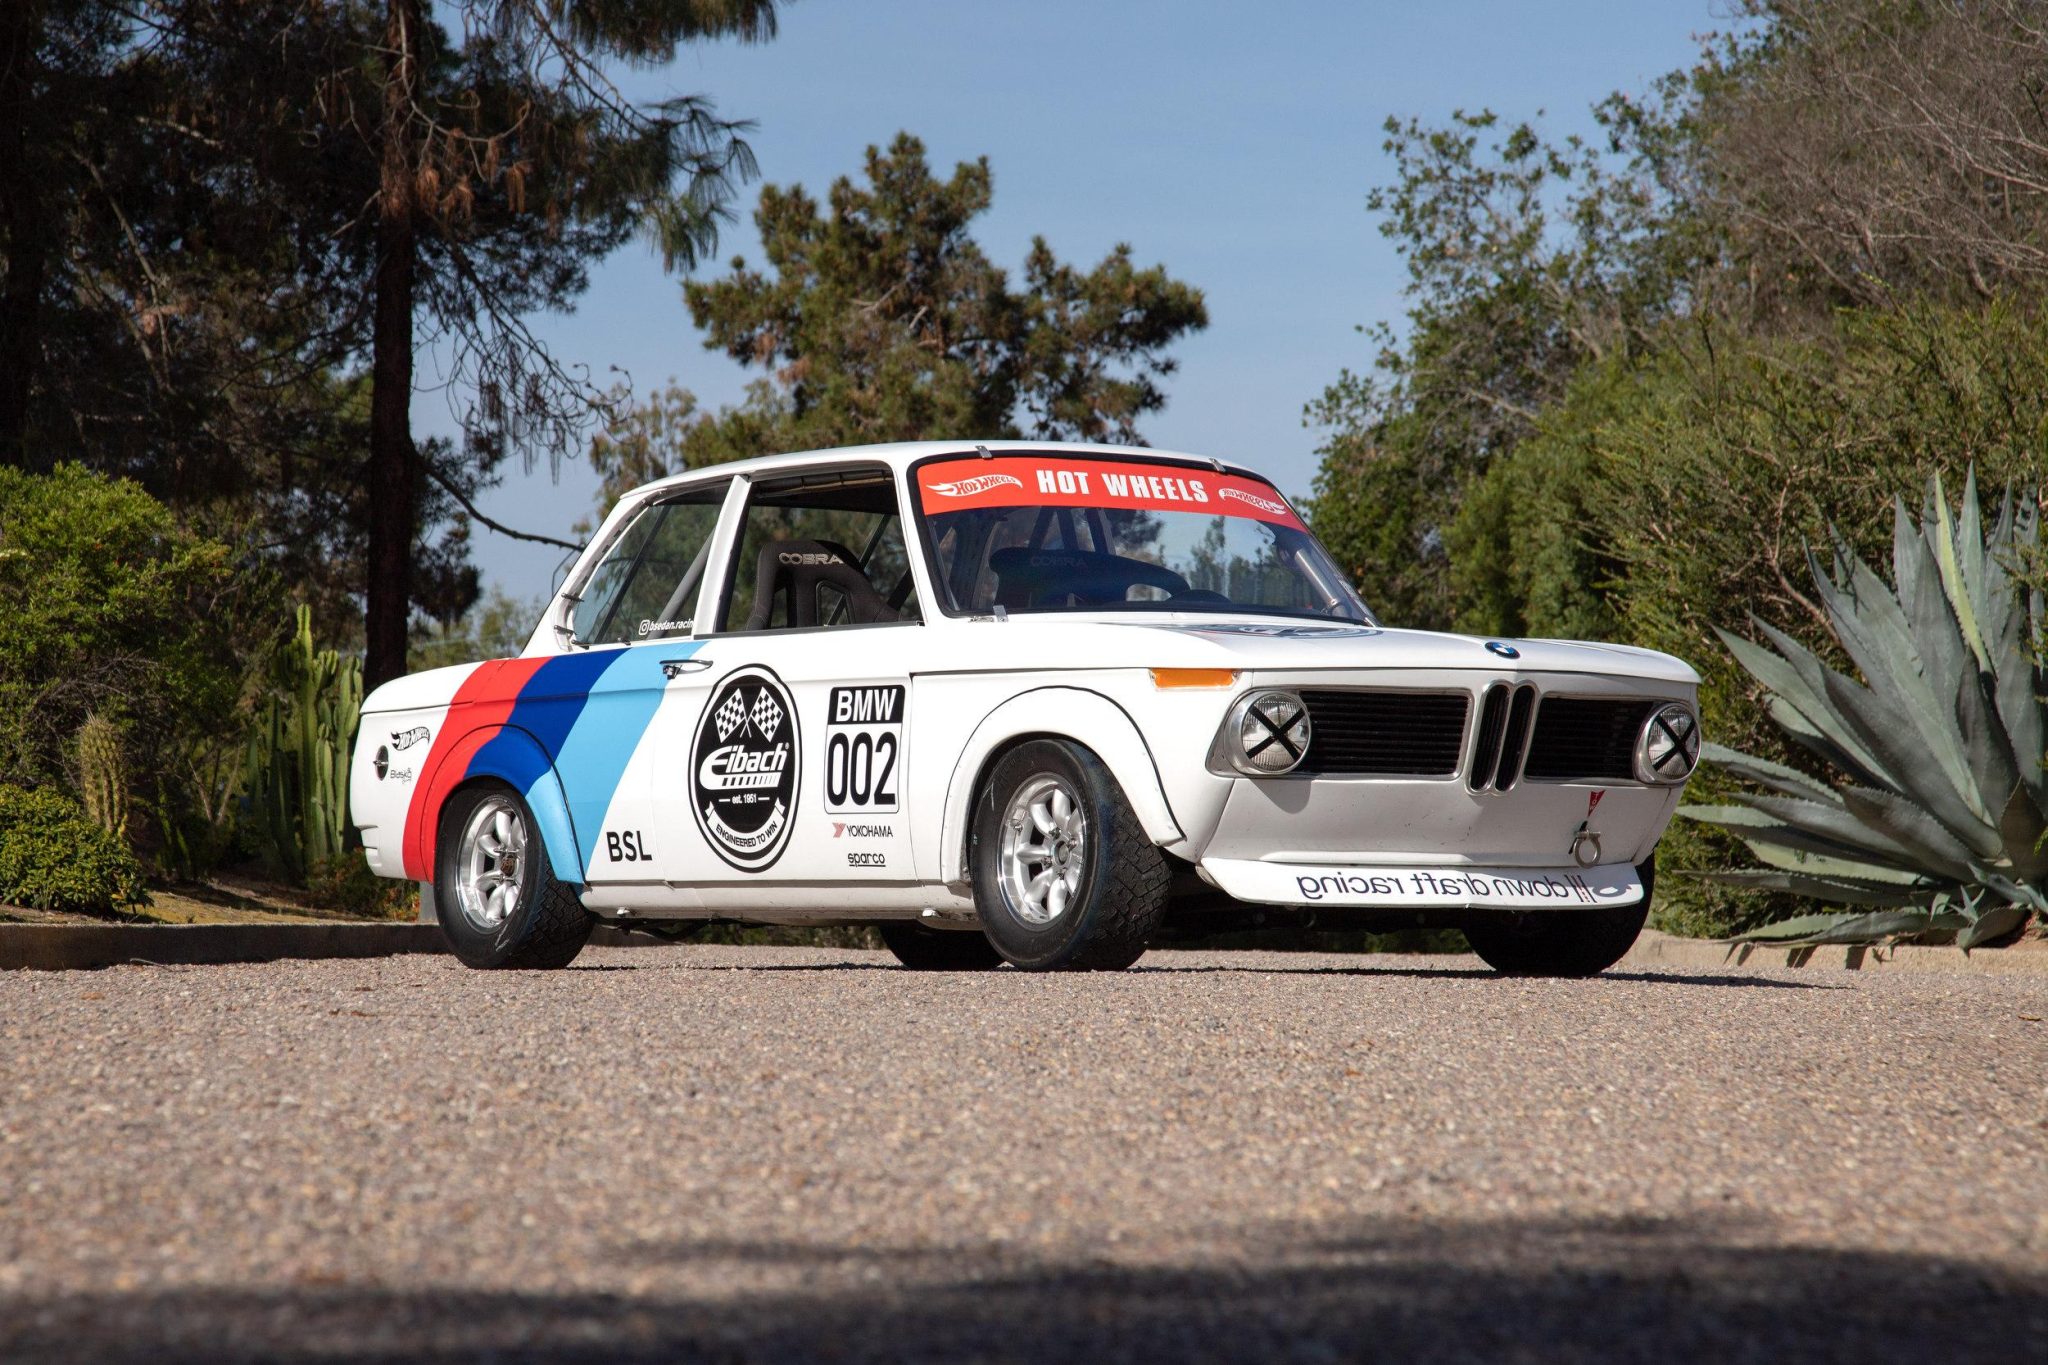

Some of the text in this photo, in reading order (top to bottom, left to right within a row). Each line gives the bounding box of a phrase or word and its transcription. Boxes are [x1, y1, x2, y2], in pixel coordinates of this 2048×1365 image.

[1036, 470, 1209, 503] HOT WHEELS
[779, 552, 845, 565] COBRA
[836, 688, 897, 722] BMW
[827, 732, 897, 806] 002
[606, 830, 653, 862] BSL
[716, 820, 778, 848] ENGINEERED TO WIN
[847, 824, 893, 838] YOKOHAMA
[848, 853, 886, 867] sparco
